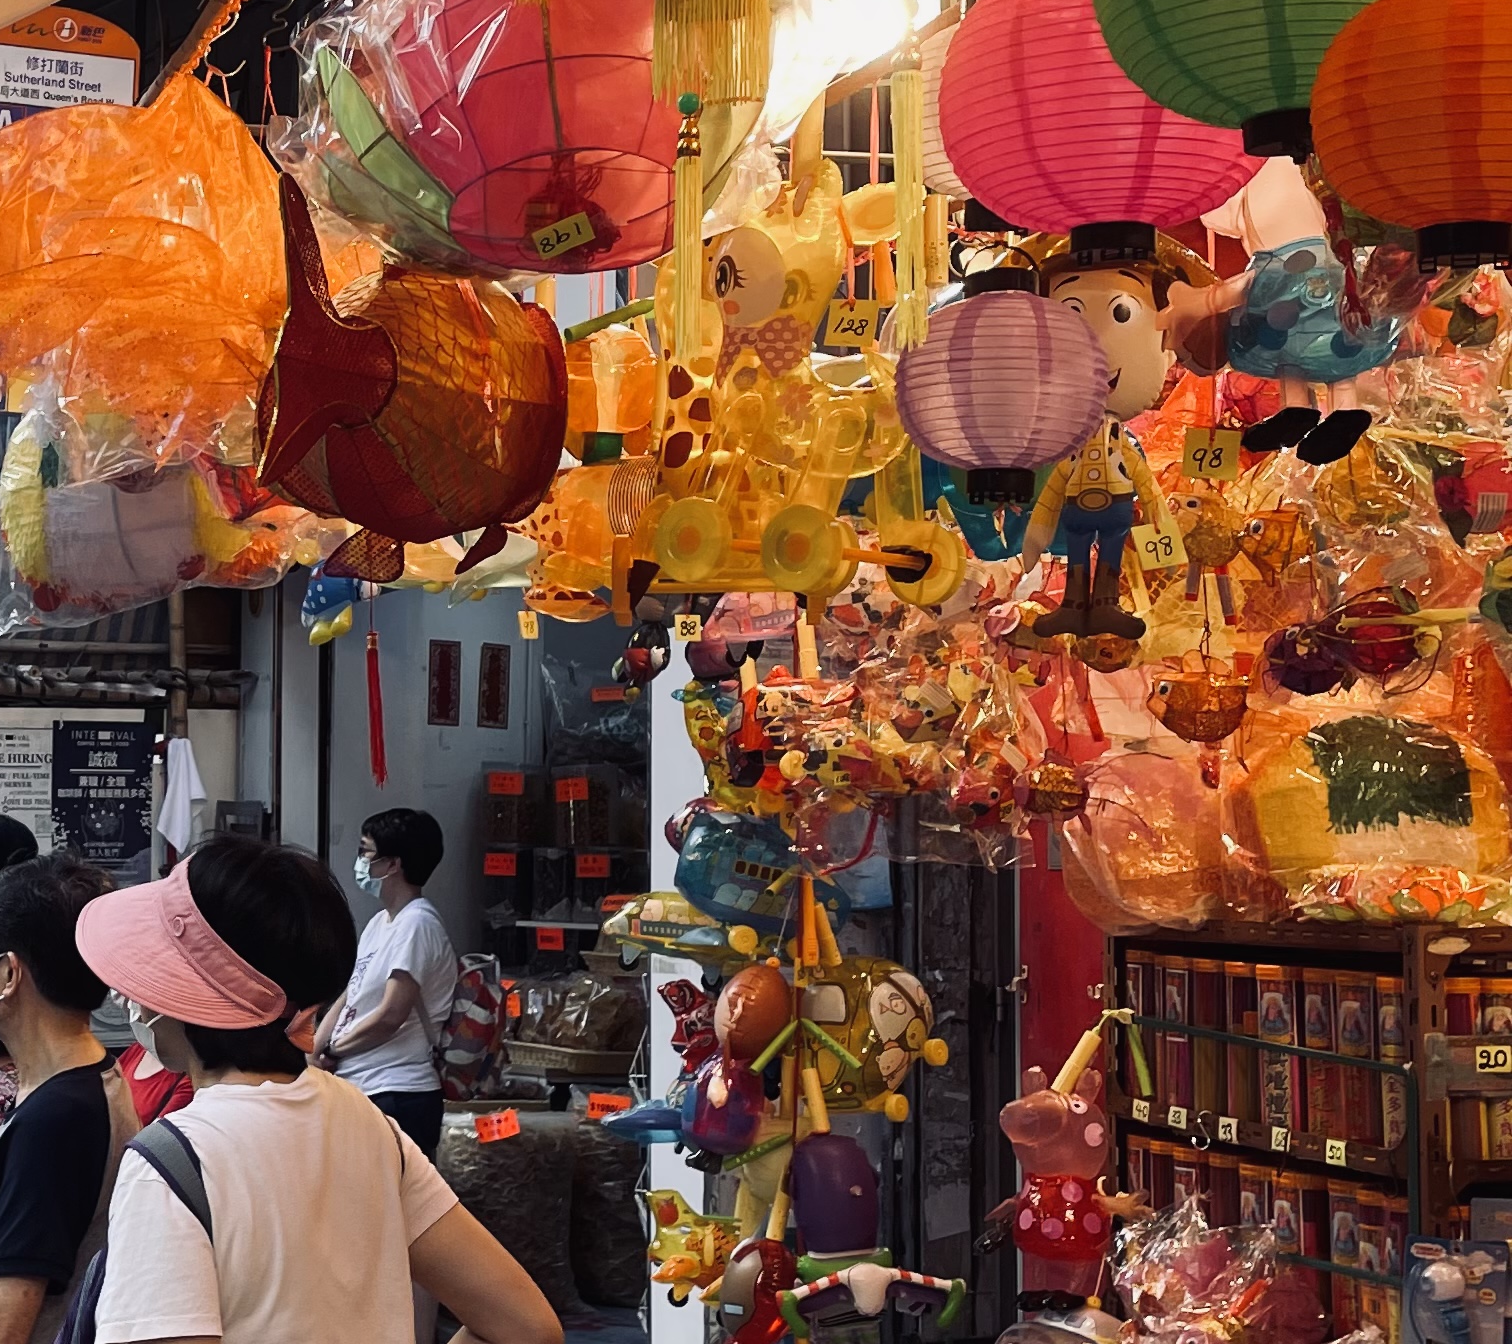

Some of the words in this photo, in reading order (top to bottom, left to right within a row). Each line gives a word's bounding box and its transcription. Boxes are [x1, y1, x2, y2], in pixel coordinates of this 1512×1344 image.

[25, 55, 85, 78] 修打蘭街
[4, 70, 66, 89] Sutherland
[68, 78, 102, 93] Street
[43, 91, 80, 104] Queen's
[832, 316, 869, 337] 128
[1192, 447, 1224, 473] 98
[1145, 535, 1173, 563] 98
[8, 753, 53, 764] HIRING
[1479, 1049, 1508, 1069] 20
[1135, 1104, 1149, 1118] 40
[1327, 1144, 1343, 1161] 50
